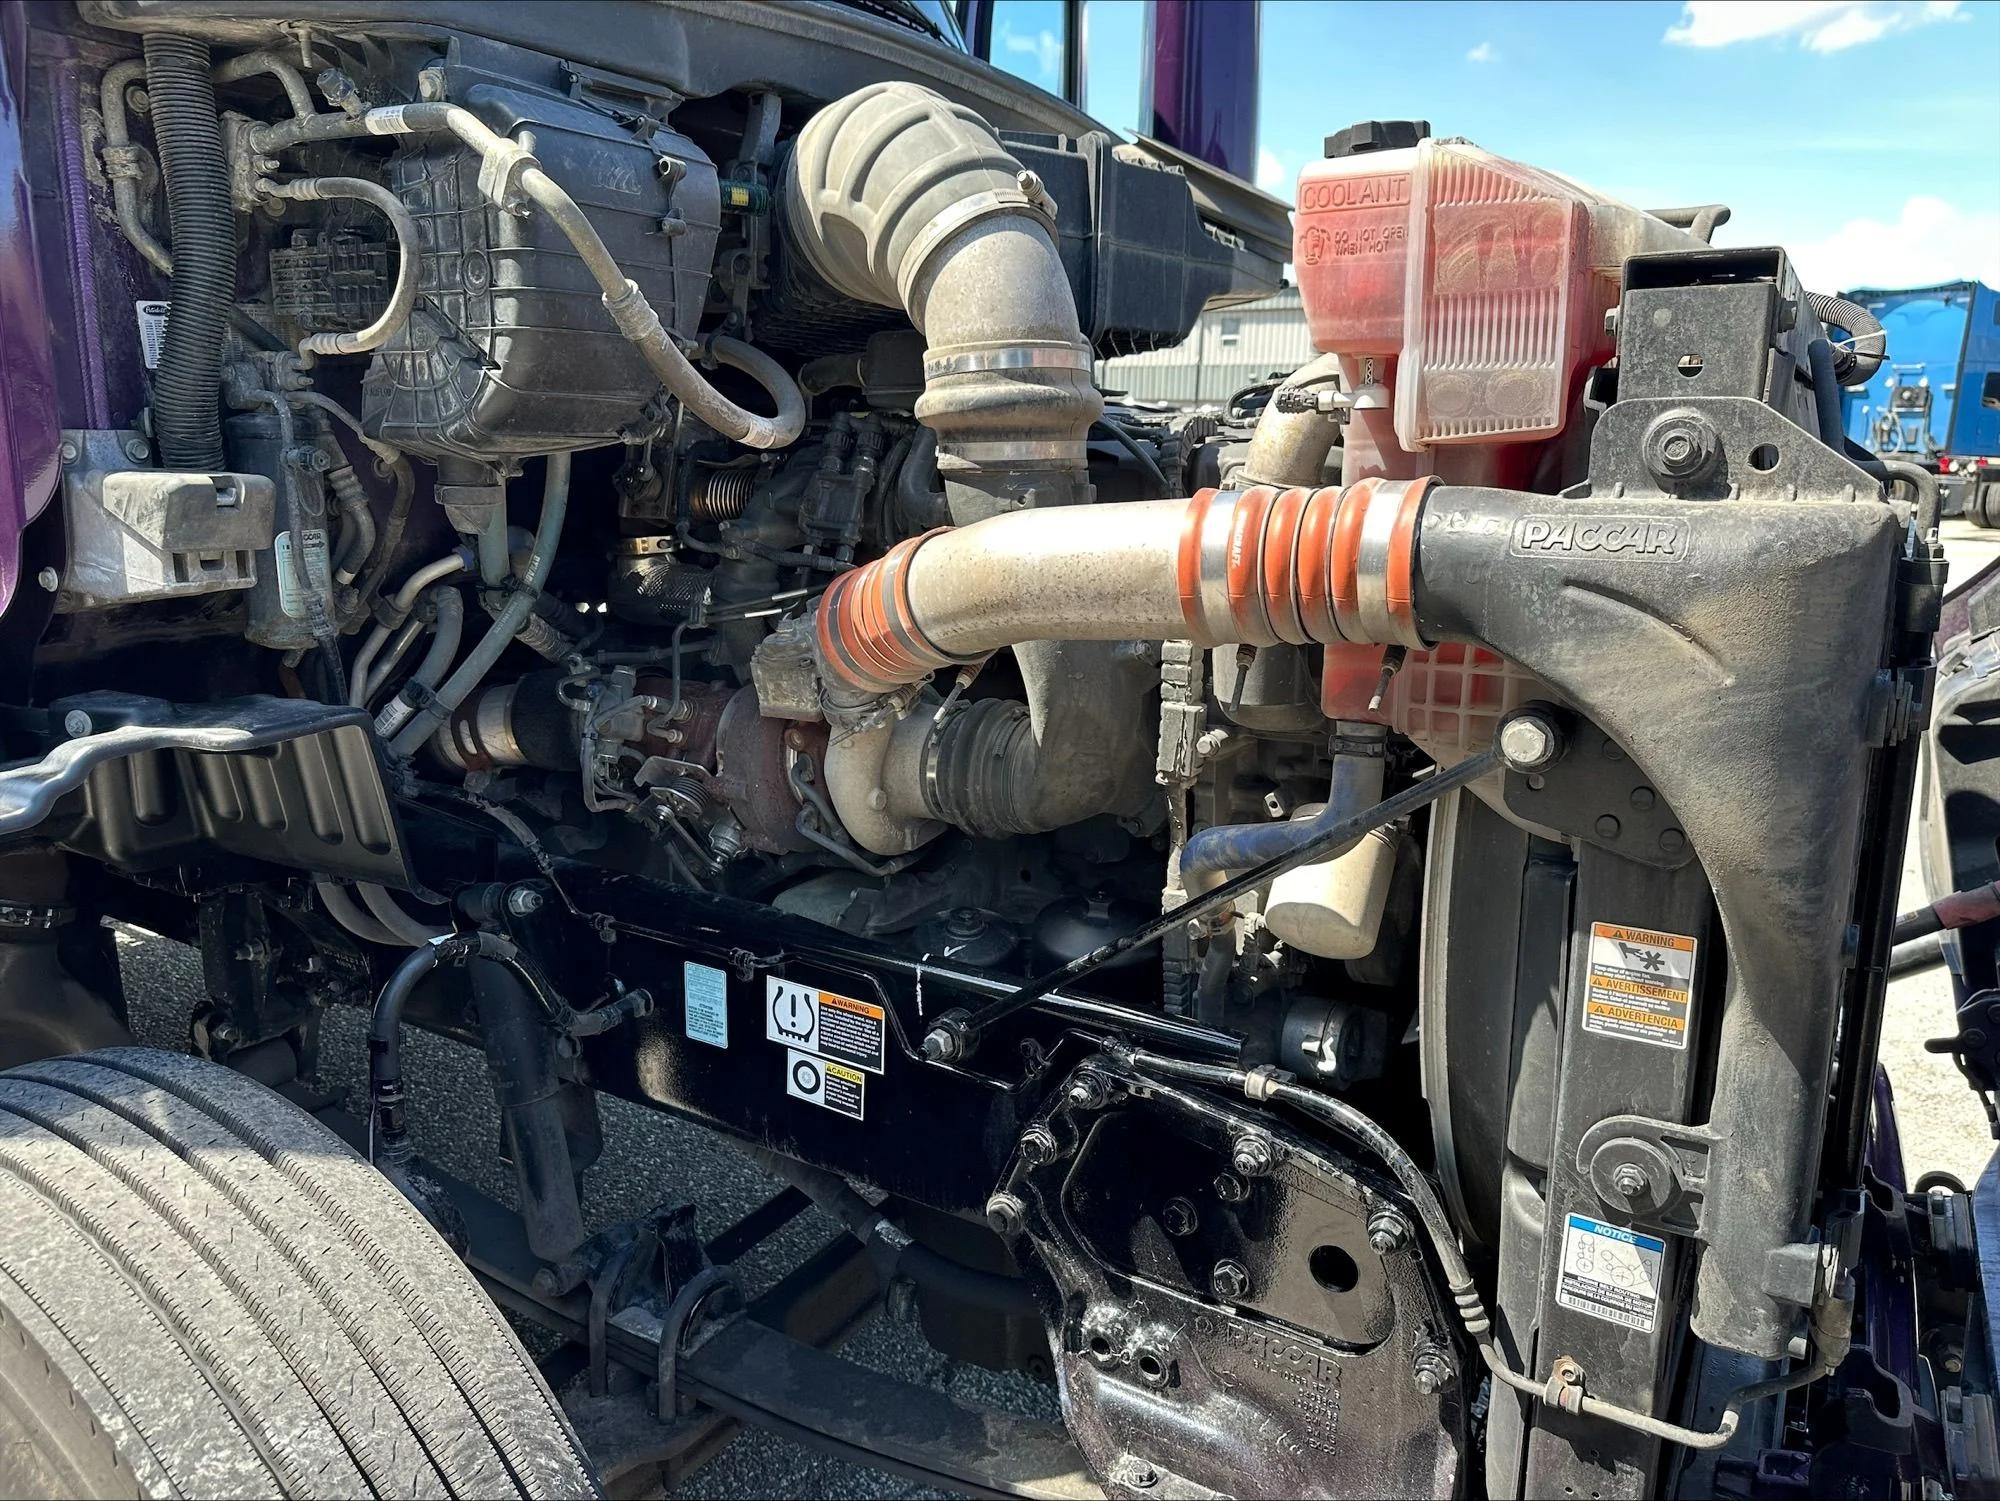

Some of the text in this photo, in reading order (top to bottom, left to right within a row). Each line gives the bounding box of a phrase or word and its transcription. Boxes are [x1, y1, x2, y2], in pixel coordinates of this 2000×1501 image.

[1304, 176, 1406, 209] COOLANT
[1334, 231, 1349, 244] DO
[1356, 228, 1376, 242] NOT
[1335, 240, 1389, 256] WHEN HOT
[1520, 519, 1678, 554] PACCAR
[1625, 930, 1675, 947] WARNING
[1605, 979, 1686, 1002] AVERTISSEMENT
[836, 999, 870, 1014] WARNING
[1607, 1007, 1678, 1028] ADVERTENCIA
[831, 1067, 862, 1083] CAUTION
[1593, 1225, 1638, 1243] NOTICE
[1227, 1322, 1343, 1387] PACCAR
